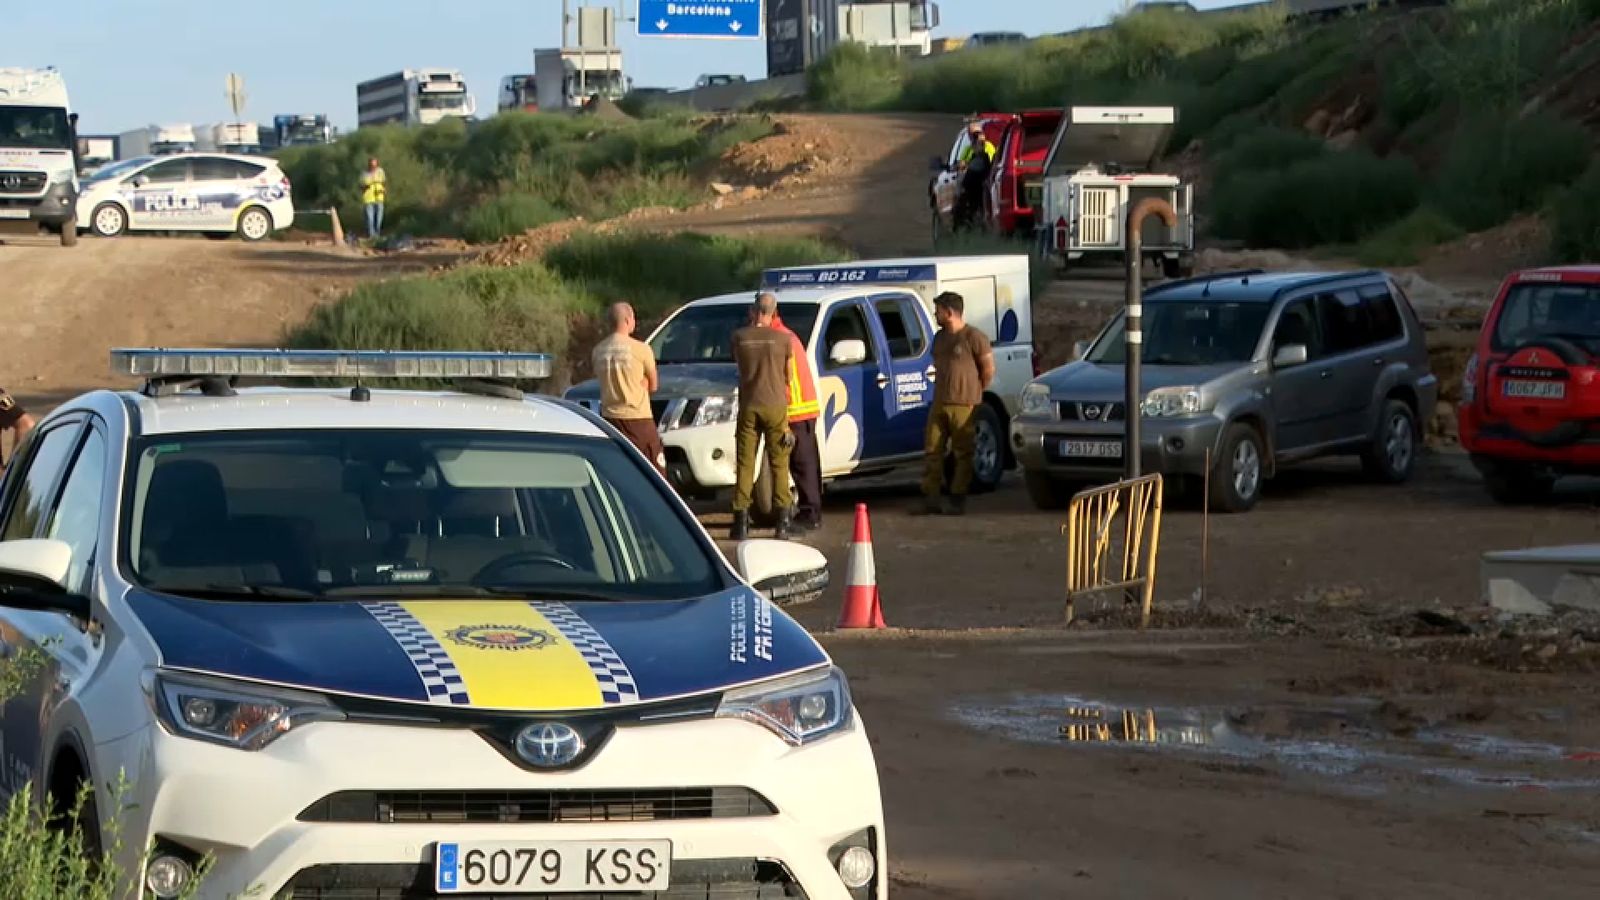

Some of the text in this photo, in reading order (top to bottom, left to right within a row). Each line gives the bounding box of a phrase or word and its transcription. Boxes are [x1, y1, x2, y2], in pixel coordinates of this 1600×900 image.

[667, 3, 731, 16] Barcelona
[817, 271, 839, 283] BD
[840, 269, 866, 281] 162
[1067, 442, 1095, 455] 2917
[464, 847, 656, 886] 6079 KSS
[444, 872, 453, 882] E
